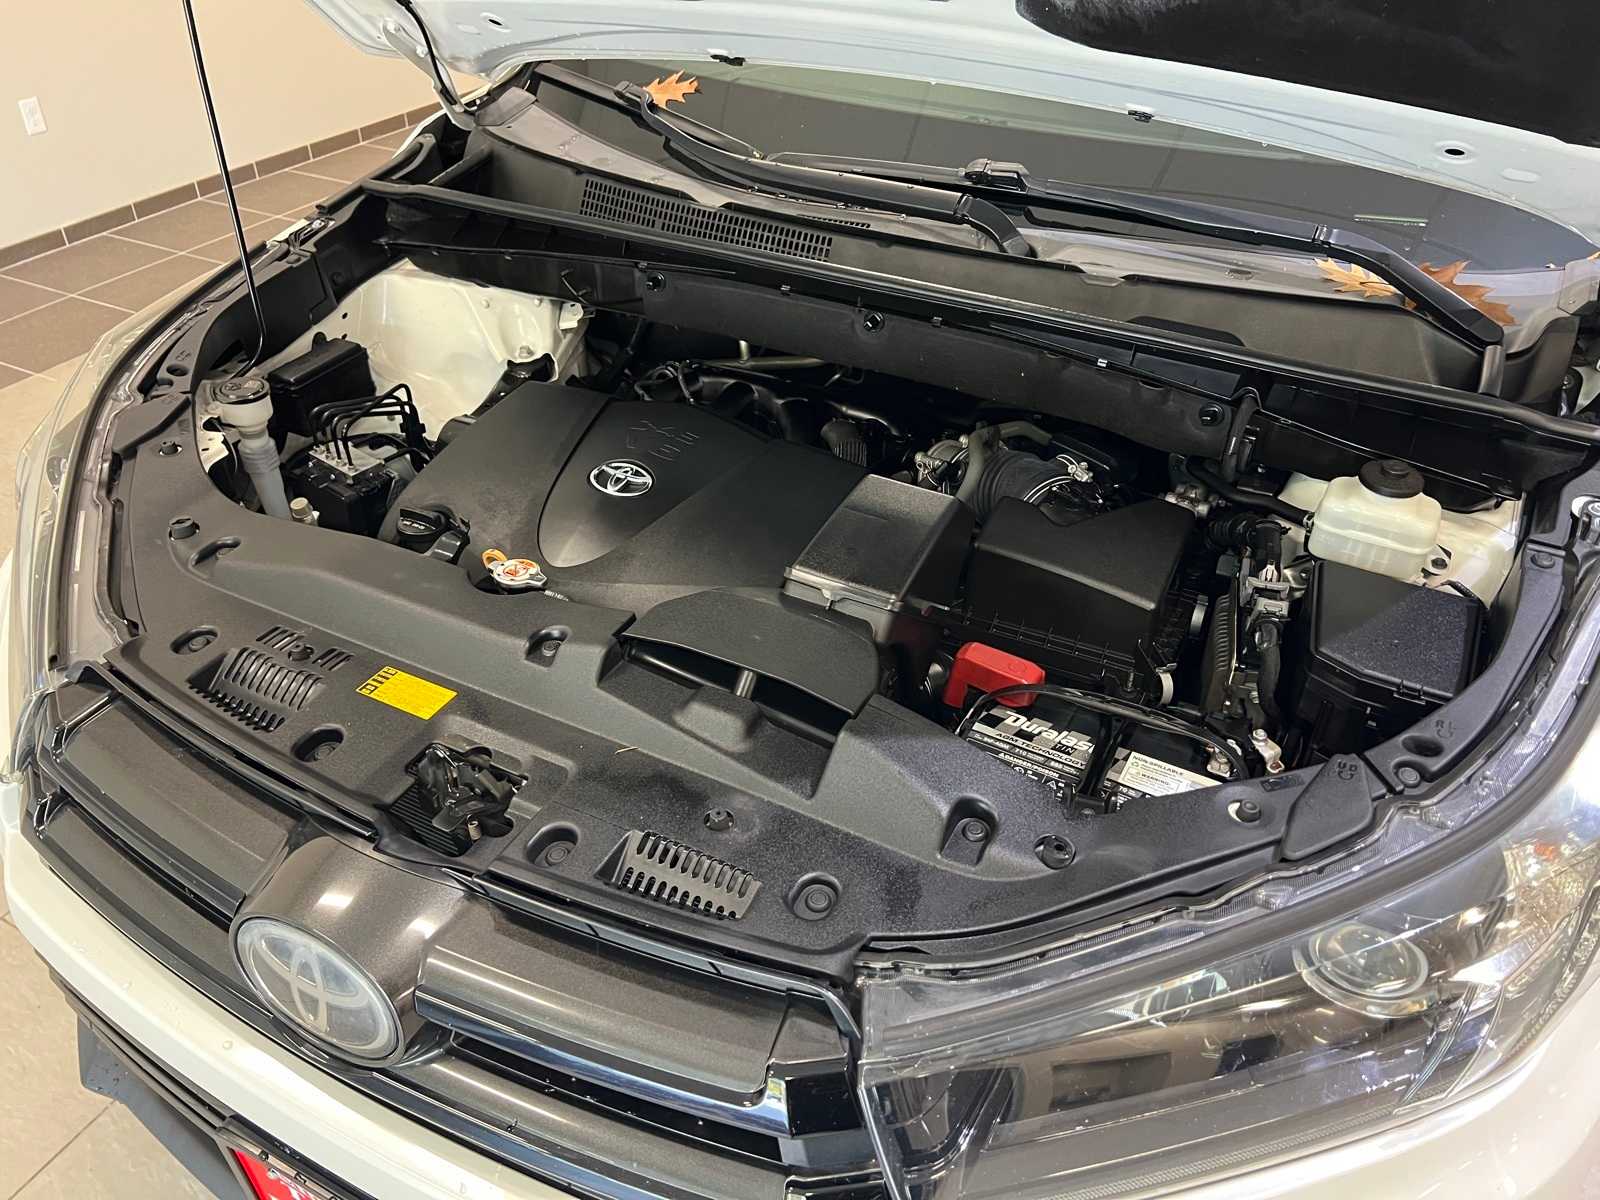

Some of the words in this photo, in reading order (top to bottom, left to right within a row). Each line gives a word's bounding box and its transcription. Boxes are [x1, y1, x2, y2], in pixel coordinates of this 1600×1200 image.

[995, 732, 1018, 744] AGM
[1021, 742, 1088, 768] TECHNOLOGY
[1004, 711, 1095, 753] Duralas
